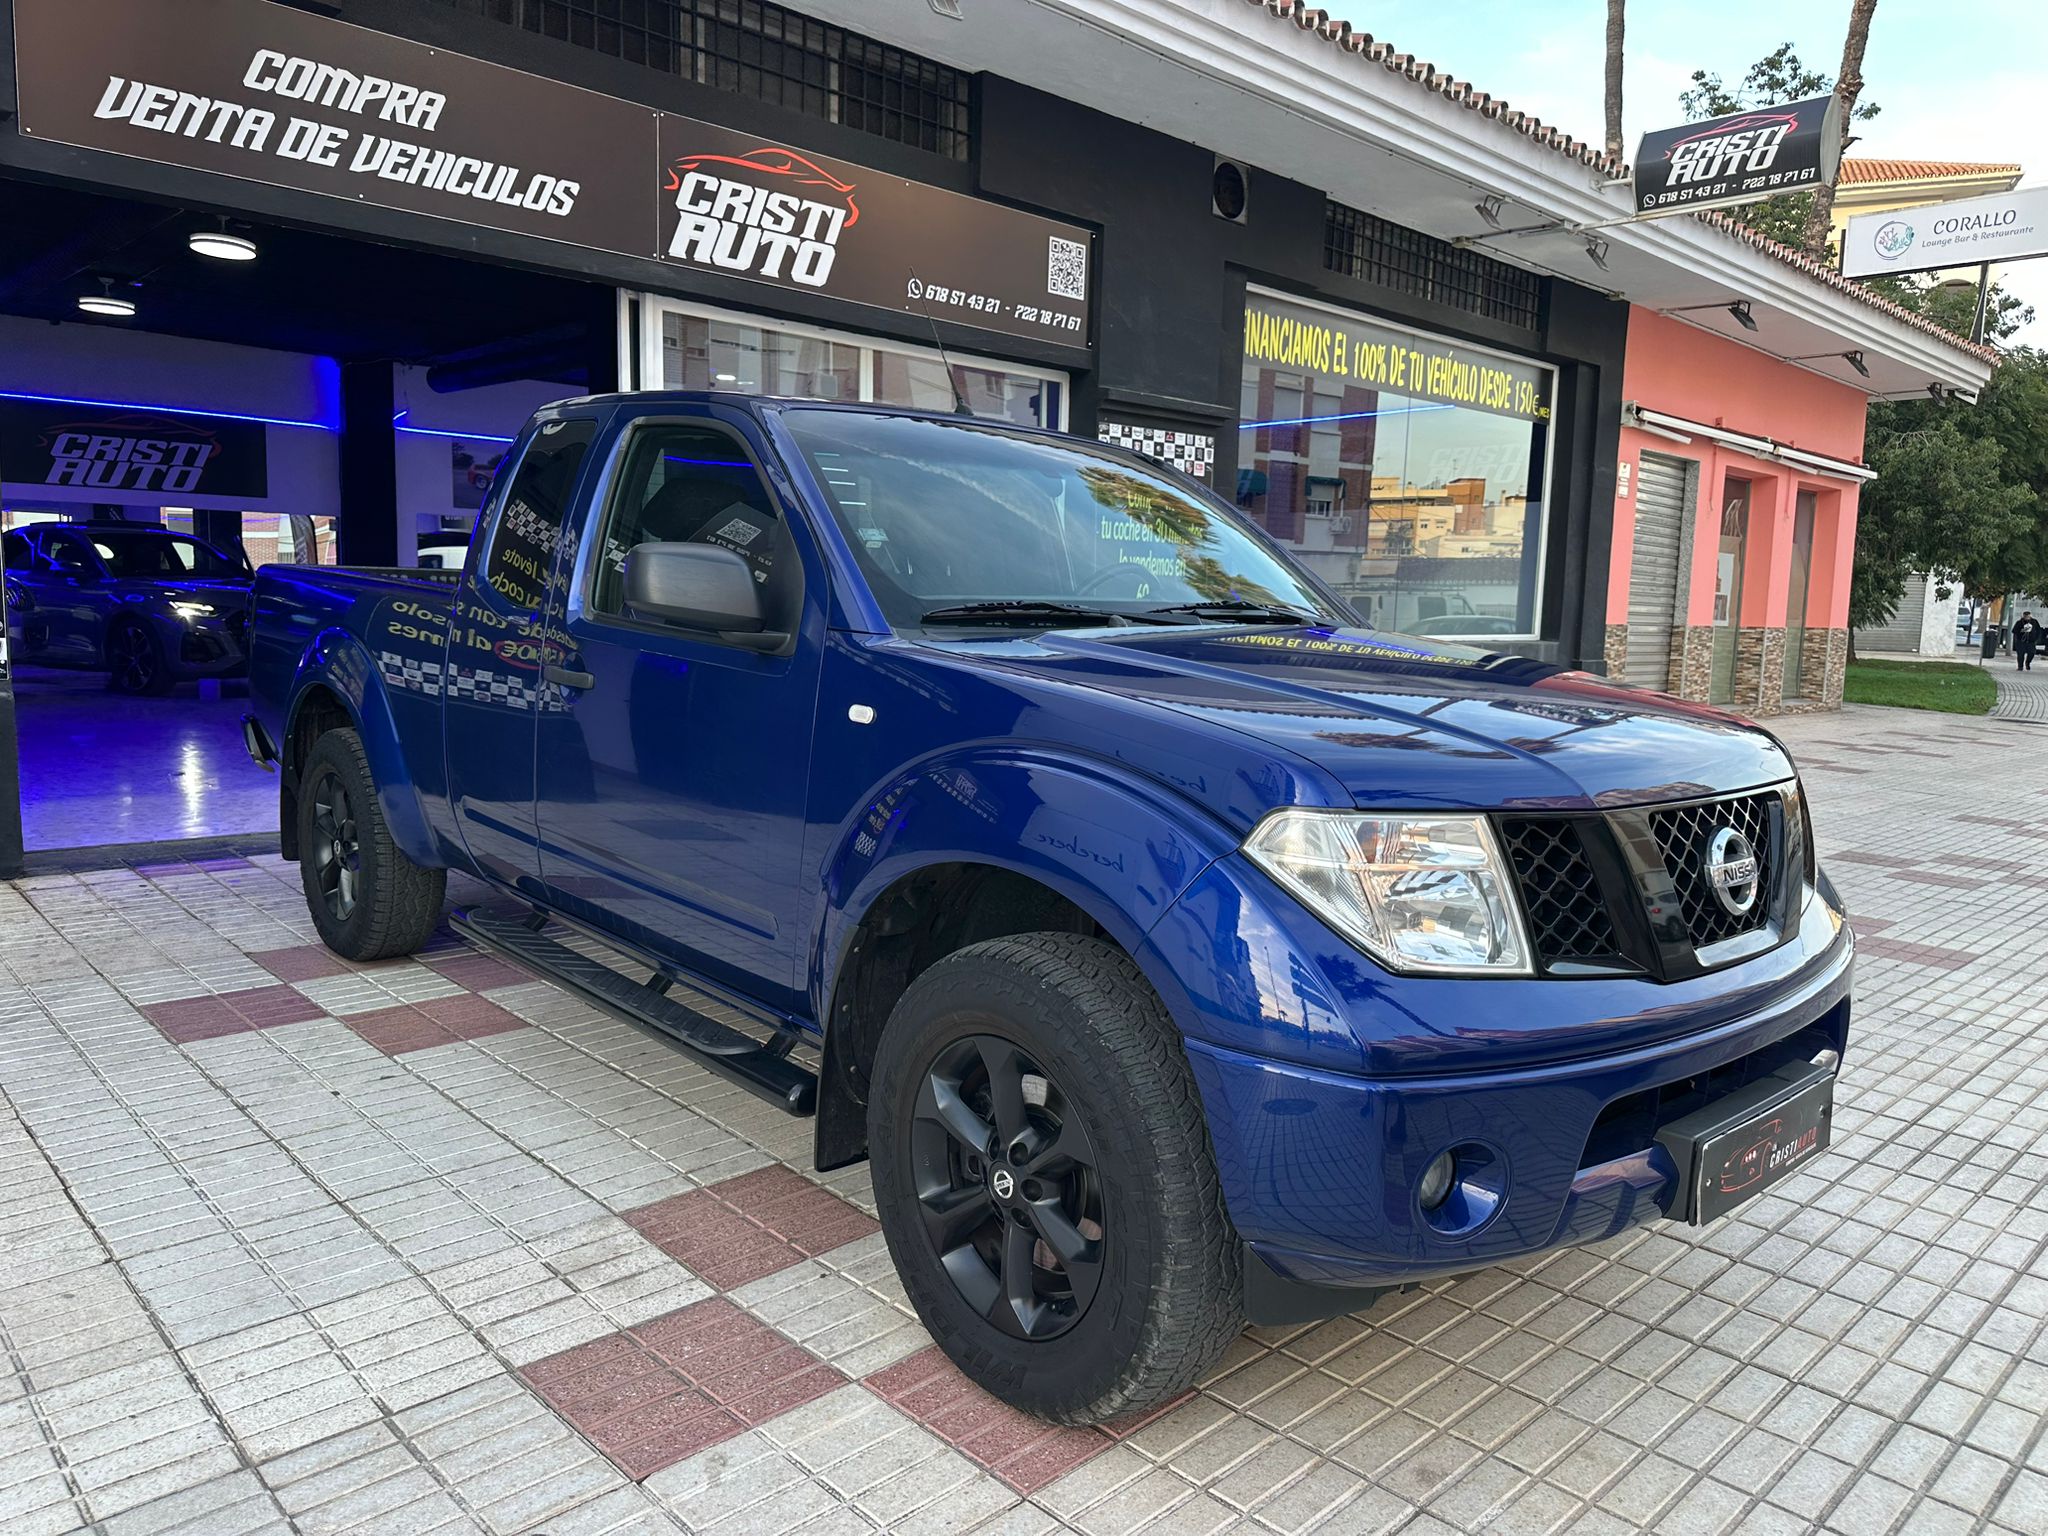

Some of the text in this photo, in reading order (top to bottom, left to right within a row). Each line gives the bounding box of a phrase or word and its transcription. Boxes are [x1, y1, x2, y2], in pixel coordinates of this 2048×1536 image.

[241, 48, 446, 132] COMPRA
[93, 75, 580, 217] VENTA DE VEHICULOS
[1670, 124, 1791, 164] CRISTI
[1658, 191, 1677, 203] 618
[1695, 185, 1710, 198] 43
[1712, 183, 1726, 195] 21
[1800, 167, 1816, 180] 61
[1666, 145, 1779, 186] AUTO
[674, 171, 846, 244] CRISTI
[1933, 209, 2017, 235] CORALLO
[668, 211, 836, 287] AUTO
[1921, 226, 2034, 248] Lounge Bar & Restaurante
[925, 284, 949, 303] 618
[967, 294, 984, 310] 43
[984, 298, 1000, 314] 21
[1039, 309, 1052, 325] 18
[1067, 317, 1081, 331] 61
[1333, 331, 1348, 375] EL
[1353, 341, 1387, 384] 100%
[1389, 345, 1407, 387] DE
[1409, 351, 1425, 392] TU
[1427, 351, 1478, 403] VEHÍCULO
[1479, 366, 1512, 409] DESDE
[49, 432, 214, 470] CRISTI
[44, 458, 205, 492] AUTO
